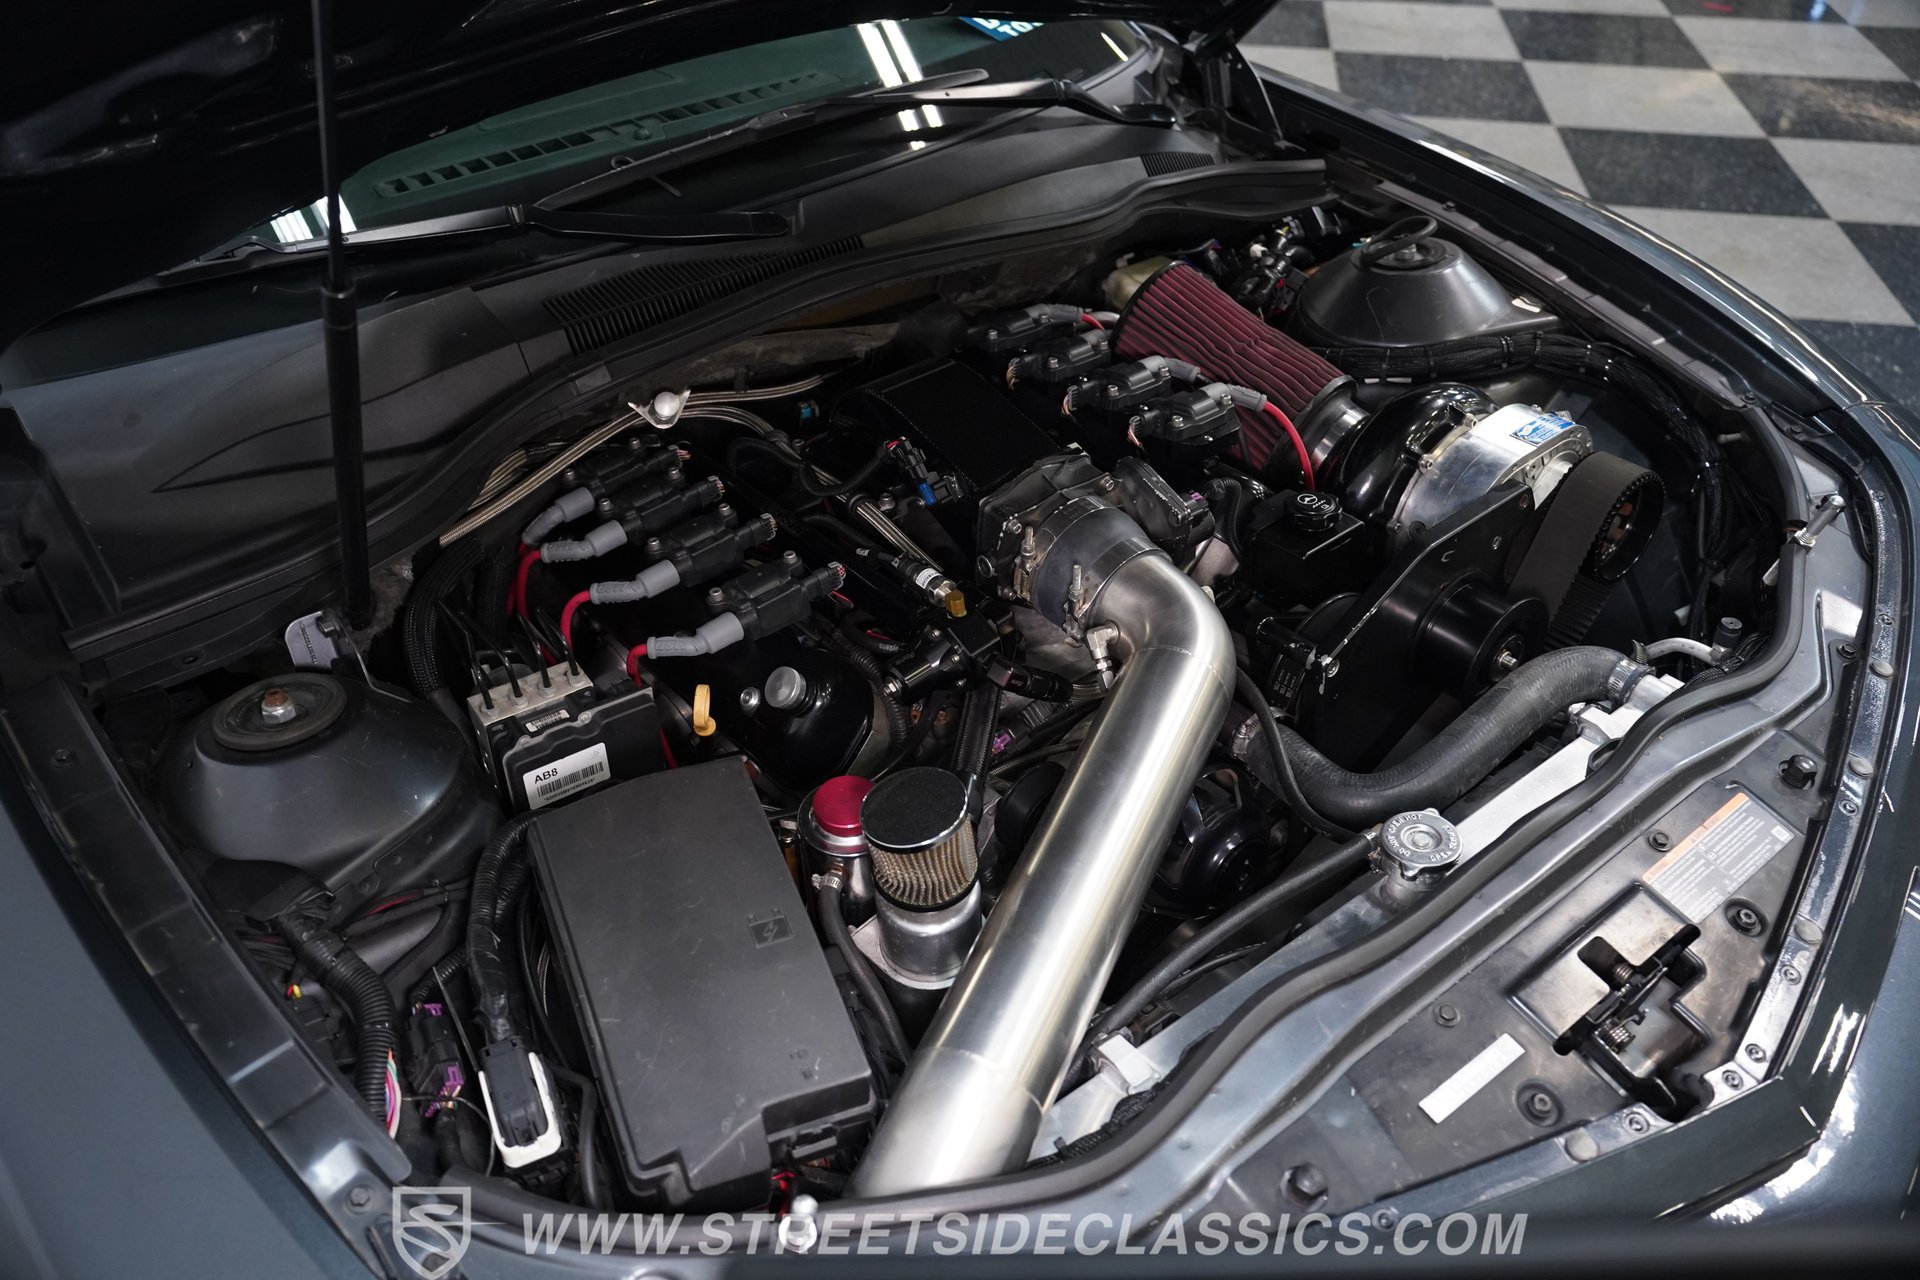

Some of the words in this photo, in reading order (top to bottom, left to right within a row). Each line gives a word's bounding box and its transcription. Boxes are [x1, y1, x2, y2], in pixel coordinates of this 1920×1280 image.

[534, 768, 558, 784] AB8
[1388, 817, 1405, 834] OPEN
[1387, 834, 1400, 848] NOT
[1399, 848, 1411, 857] DO
